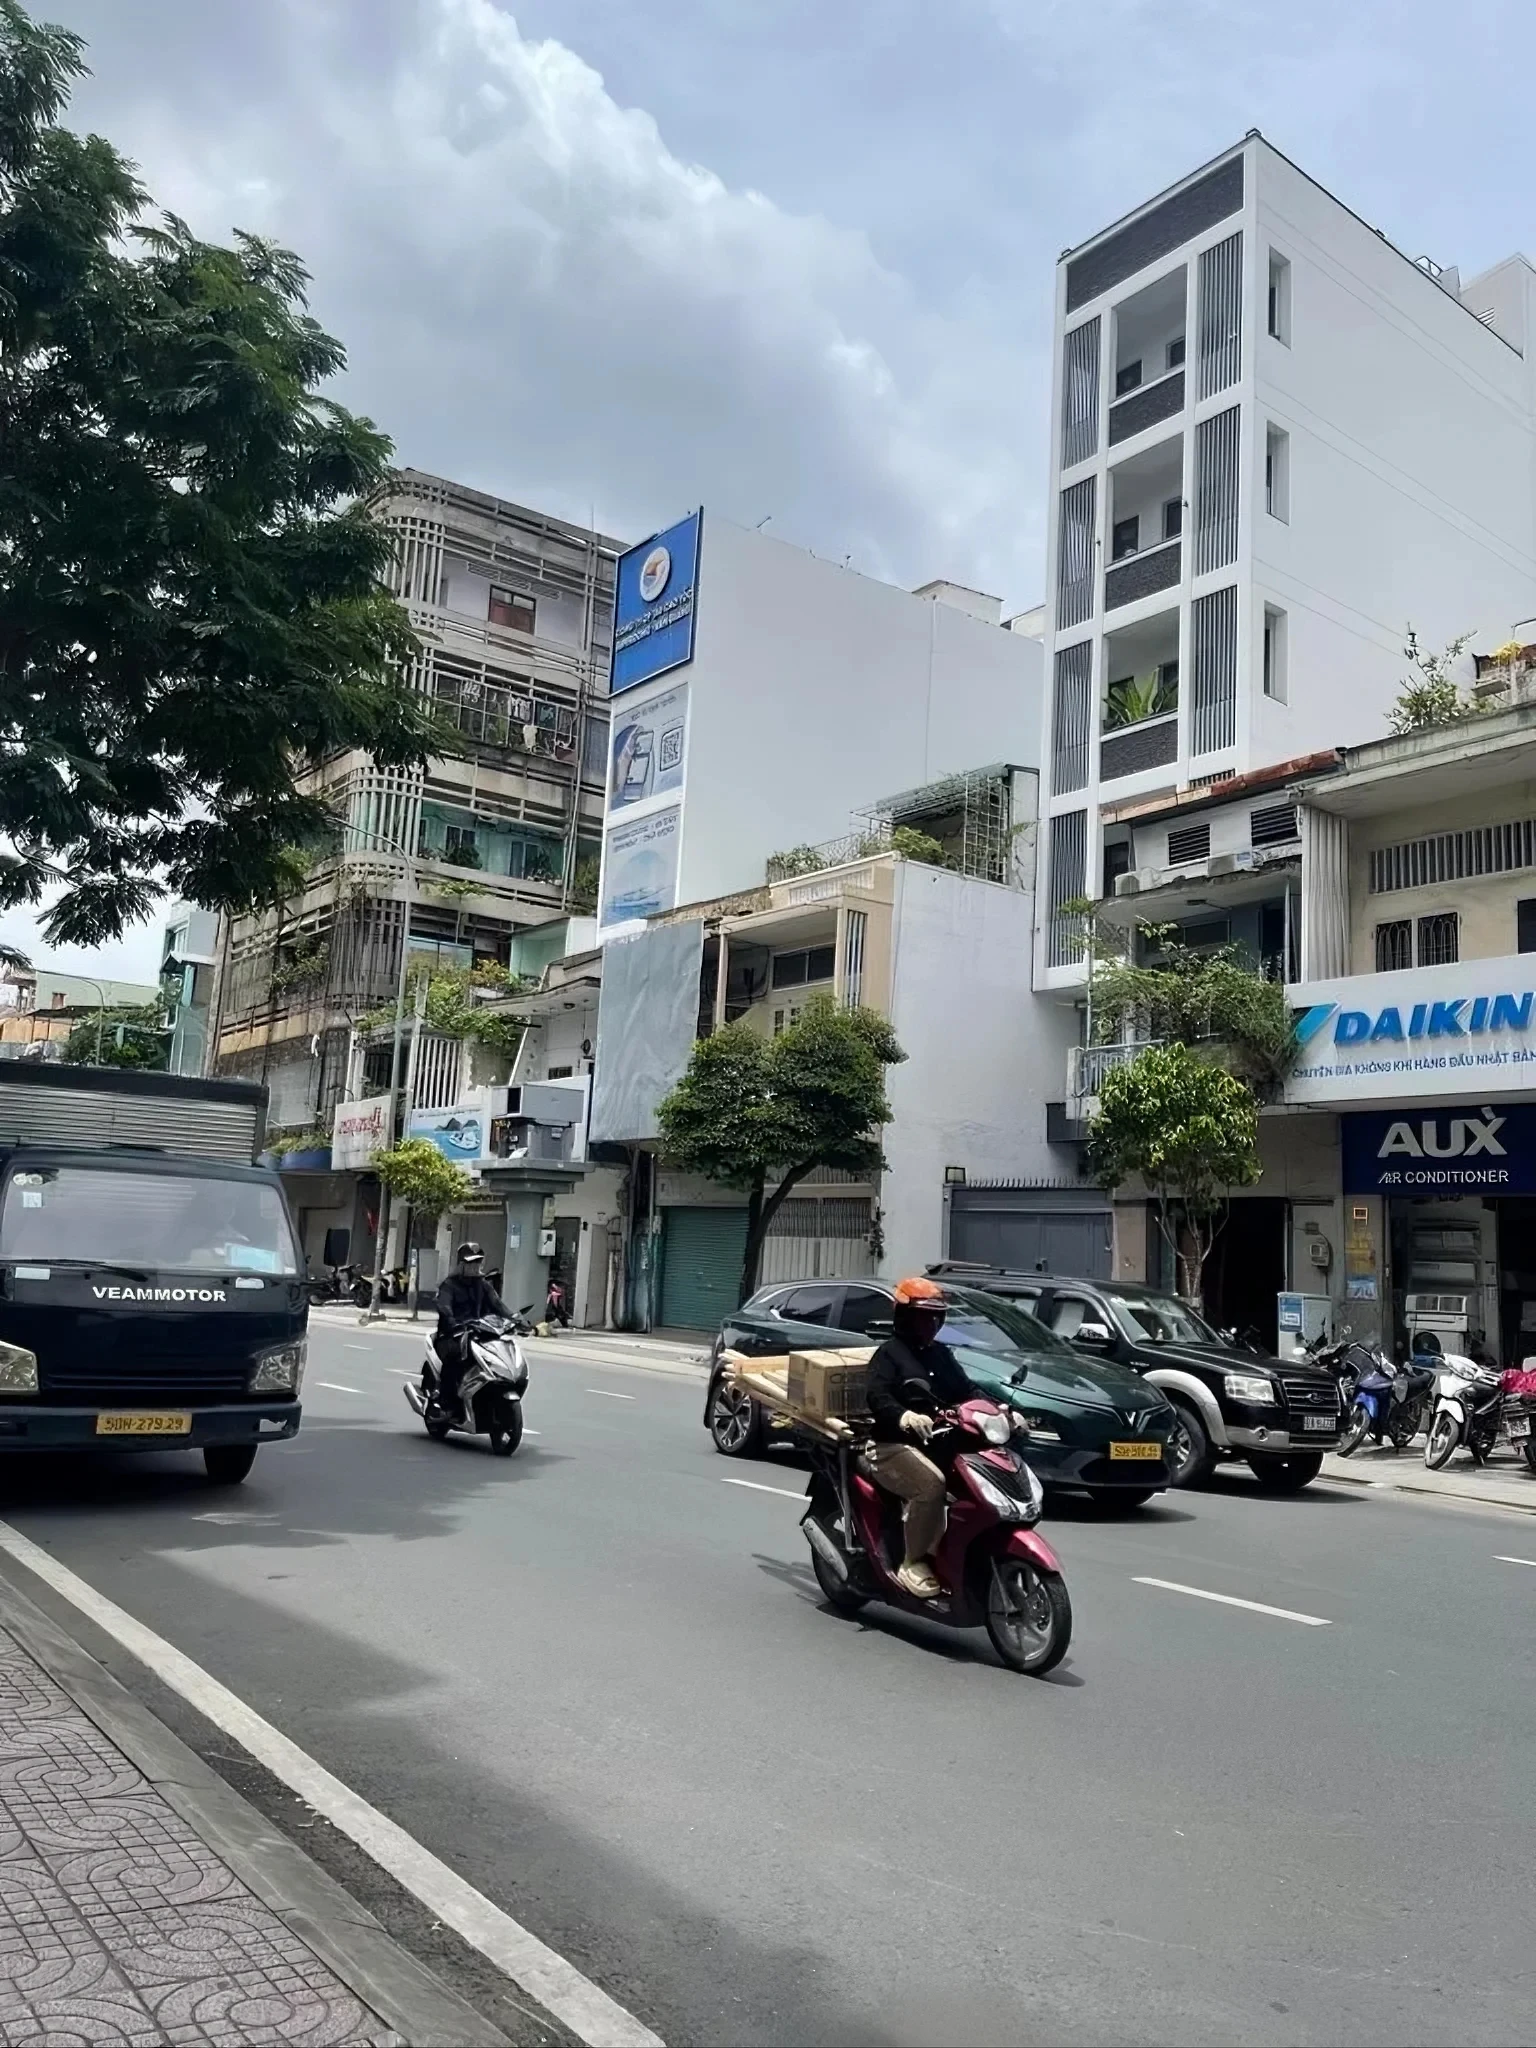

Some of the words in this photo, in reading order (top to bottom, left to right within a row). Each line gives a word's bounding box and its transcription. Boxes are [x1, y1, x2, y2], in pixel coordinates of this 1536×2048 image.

[1334, 992, 1534, 1044] DAIKIN
[1377, 1106, 1508, 1157] AUX
[1405, 1170, 1509, 1184] CONDITIONER
[92, 1286, 227, 1302] VEAMMOTOR
